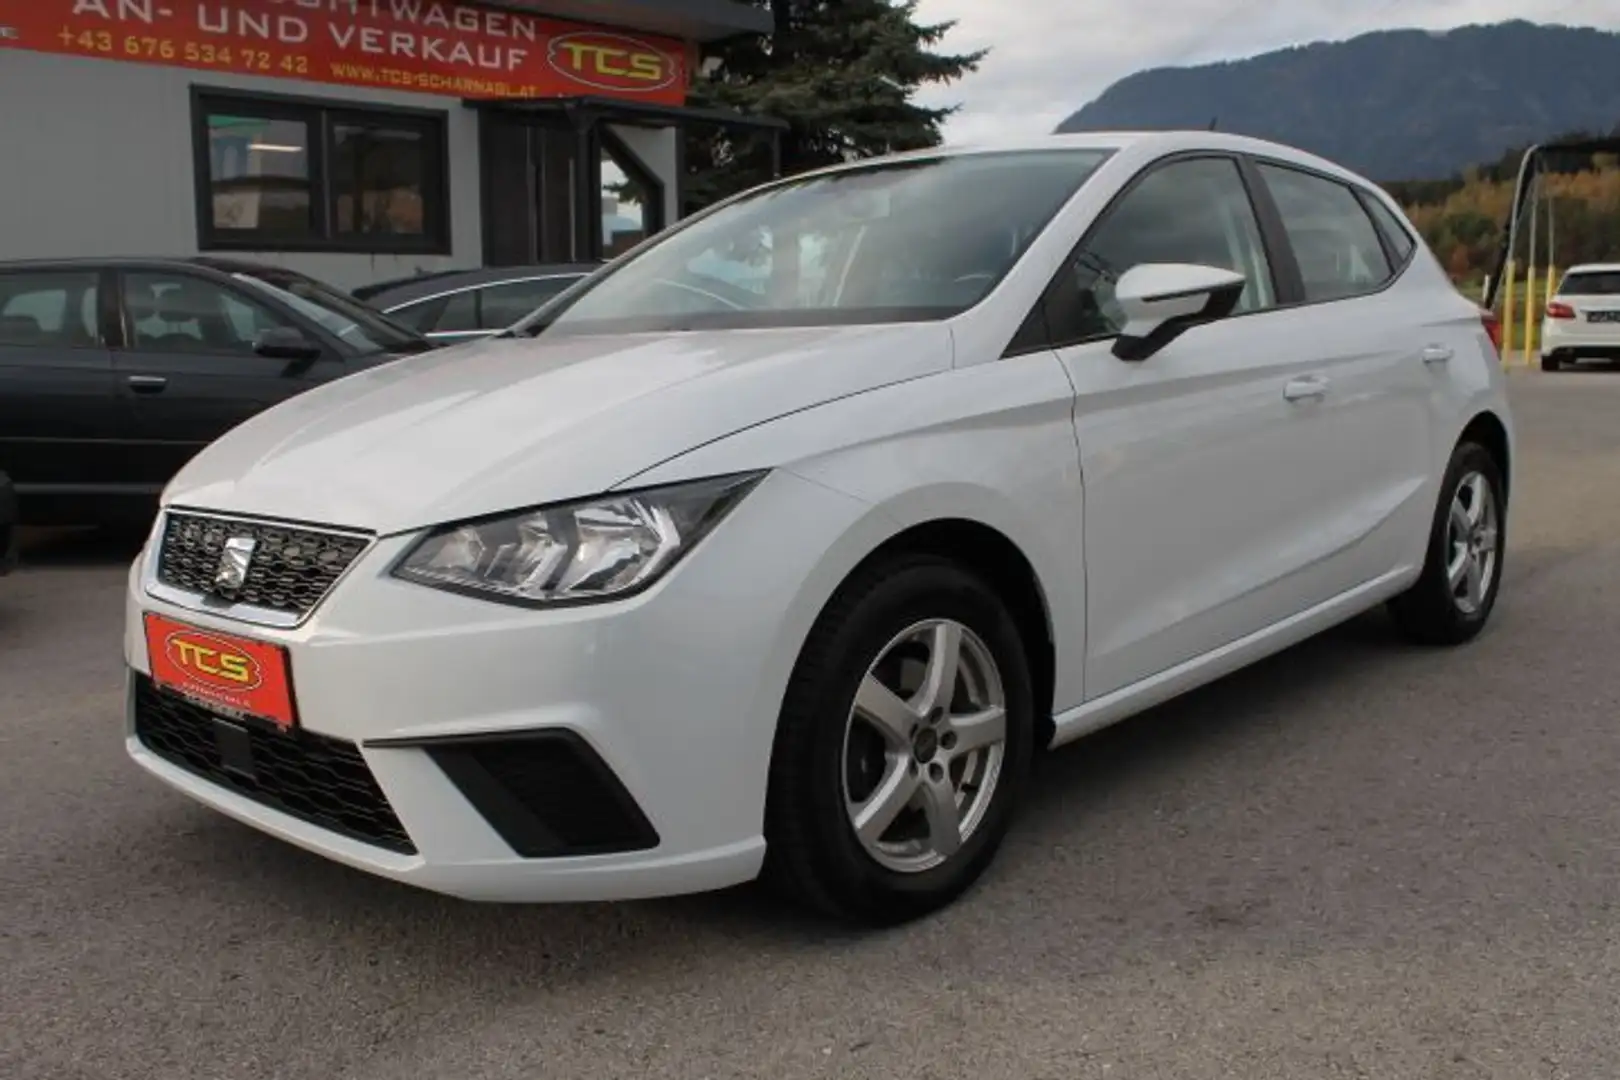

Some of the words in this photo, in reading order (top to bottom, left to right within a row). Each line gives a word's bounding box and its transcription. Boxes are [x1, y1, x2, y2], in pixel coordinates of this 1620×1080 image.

[57, 24, 112, 51] +43
[123, 36, 175, 58] 676
[184, 42, 232, 63] 534
[241, 49, 270, 70] 72
[279, 56, 308, 73] 42
[72, 0, 173, 23] AN-
[198, 7, 308, 43] UND
[327, 20, 528, 72] VERKAUF
[558, 42, 662, 80] TCS
[169, 638, 249, 682] TCS
